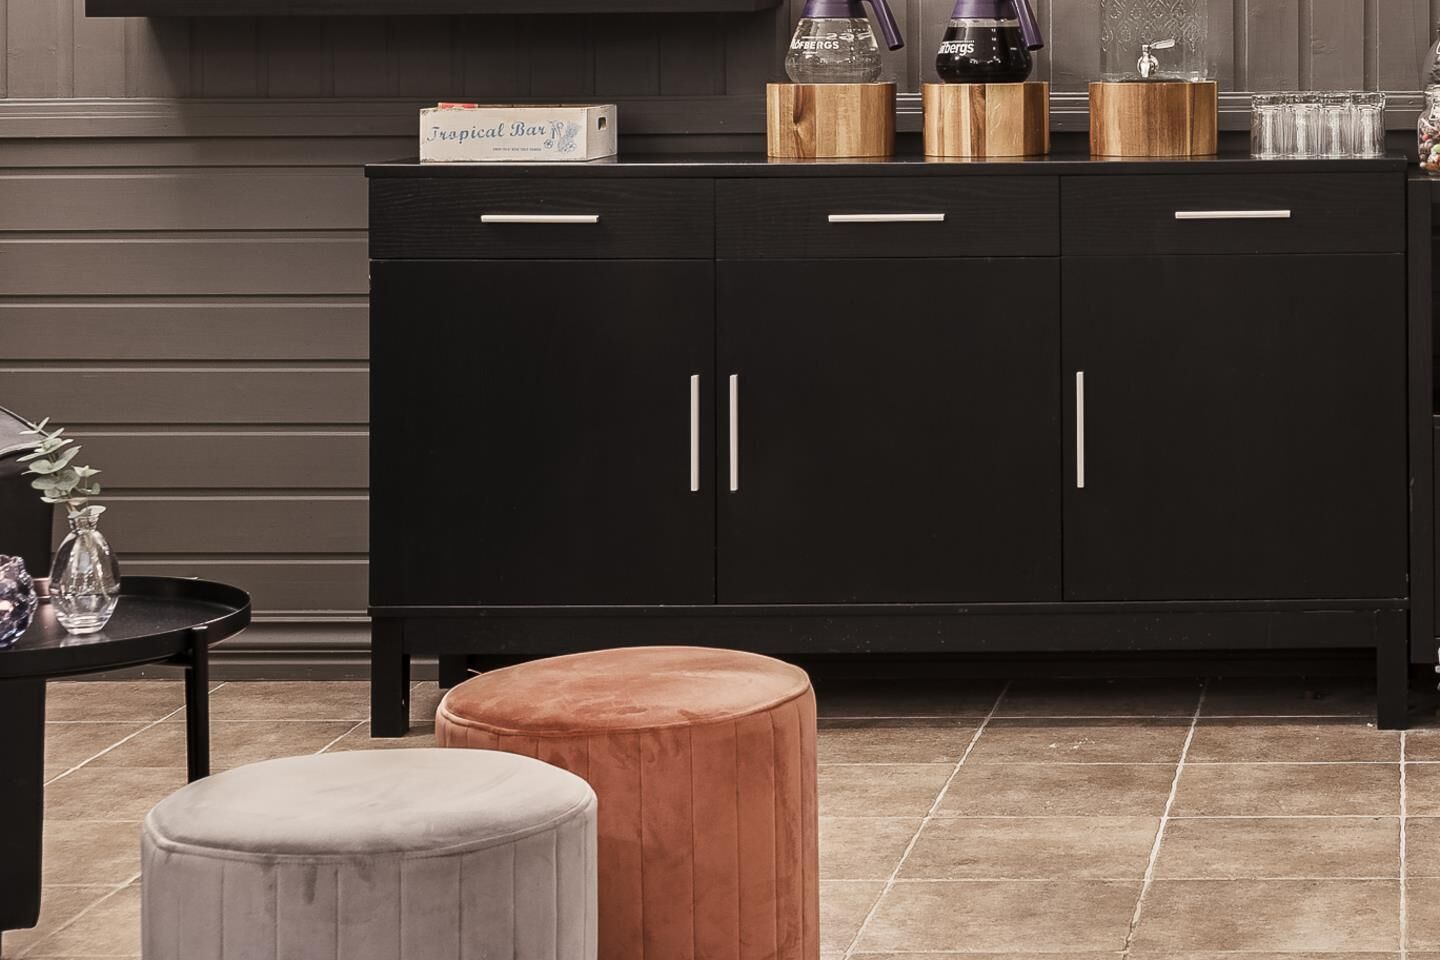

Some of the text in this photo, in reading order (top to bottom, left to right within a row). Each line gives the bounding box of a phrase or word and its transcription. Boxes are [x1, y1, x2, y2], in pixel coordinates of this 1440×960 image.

[938, 43, 974, 56] bergs
[427, 121, 547, 144] Tropical Bar
